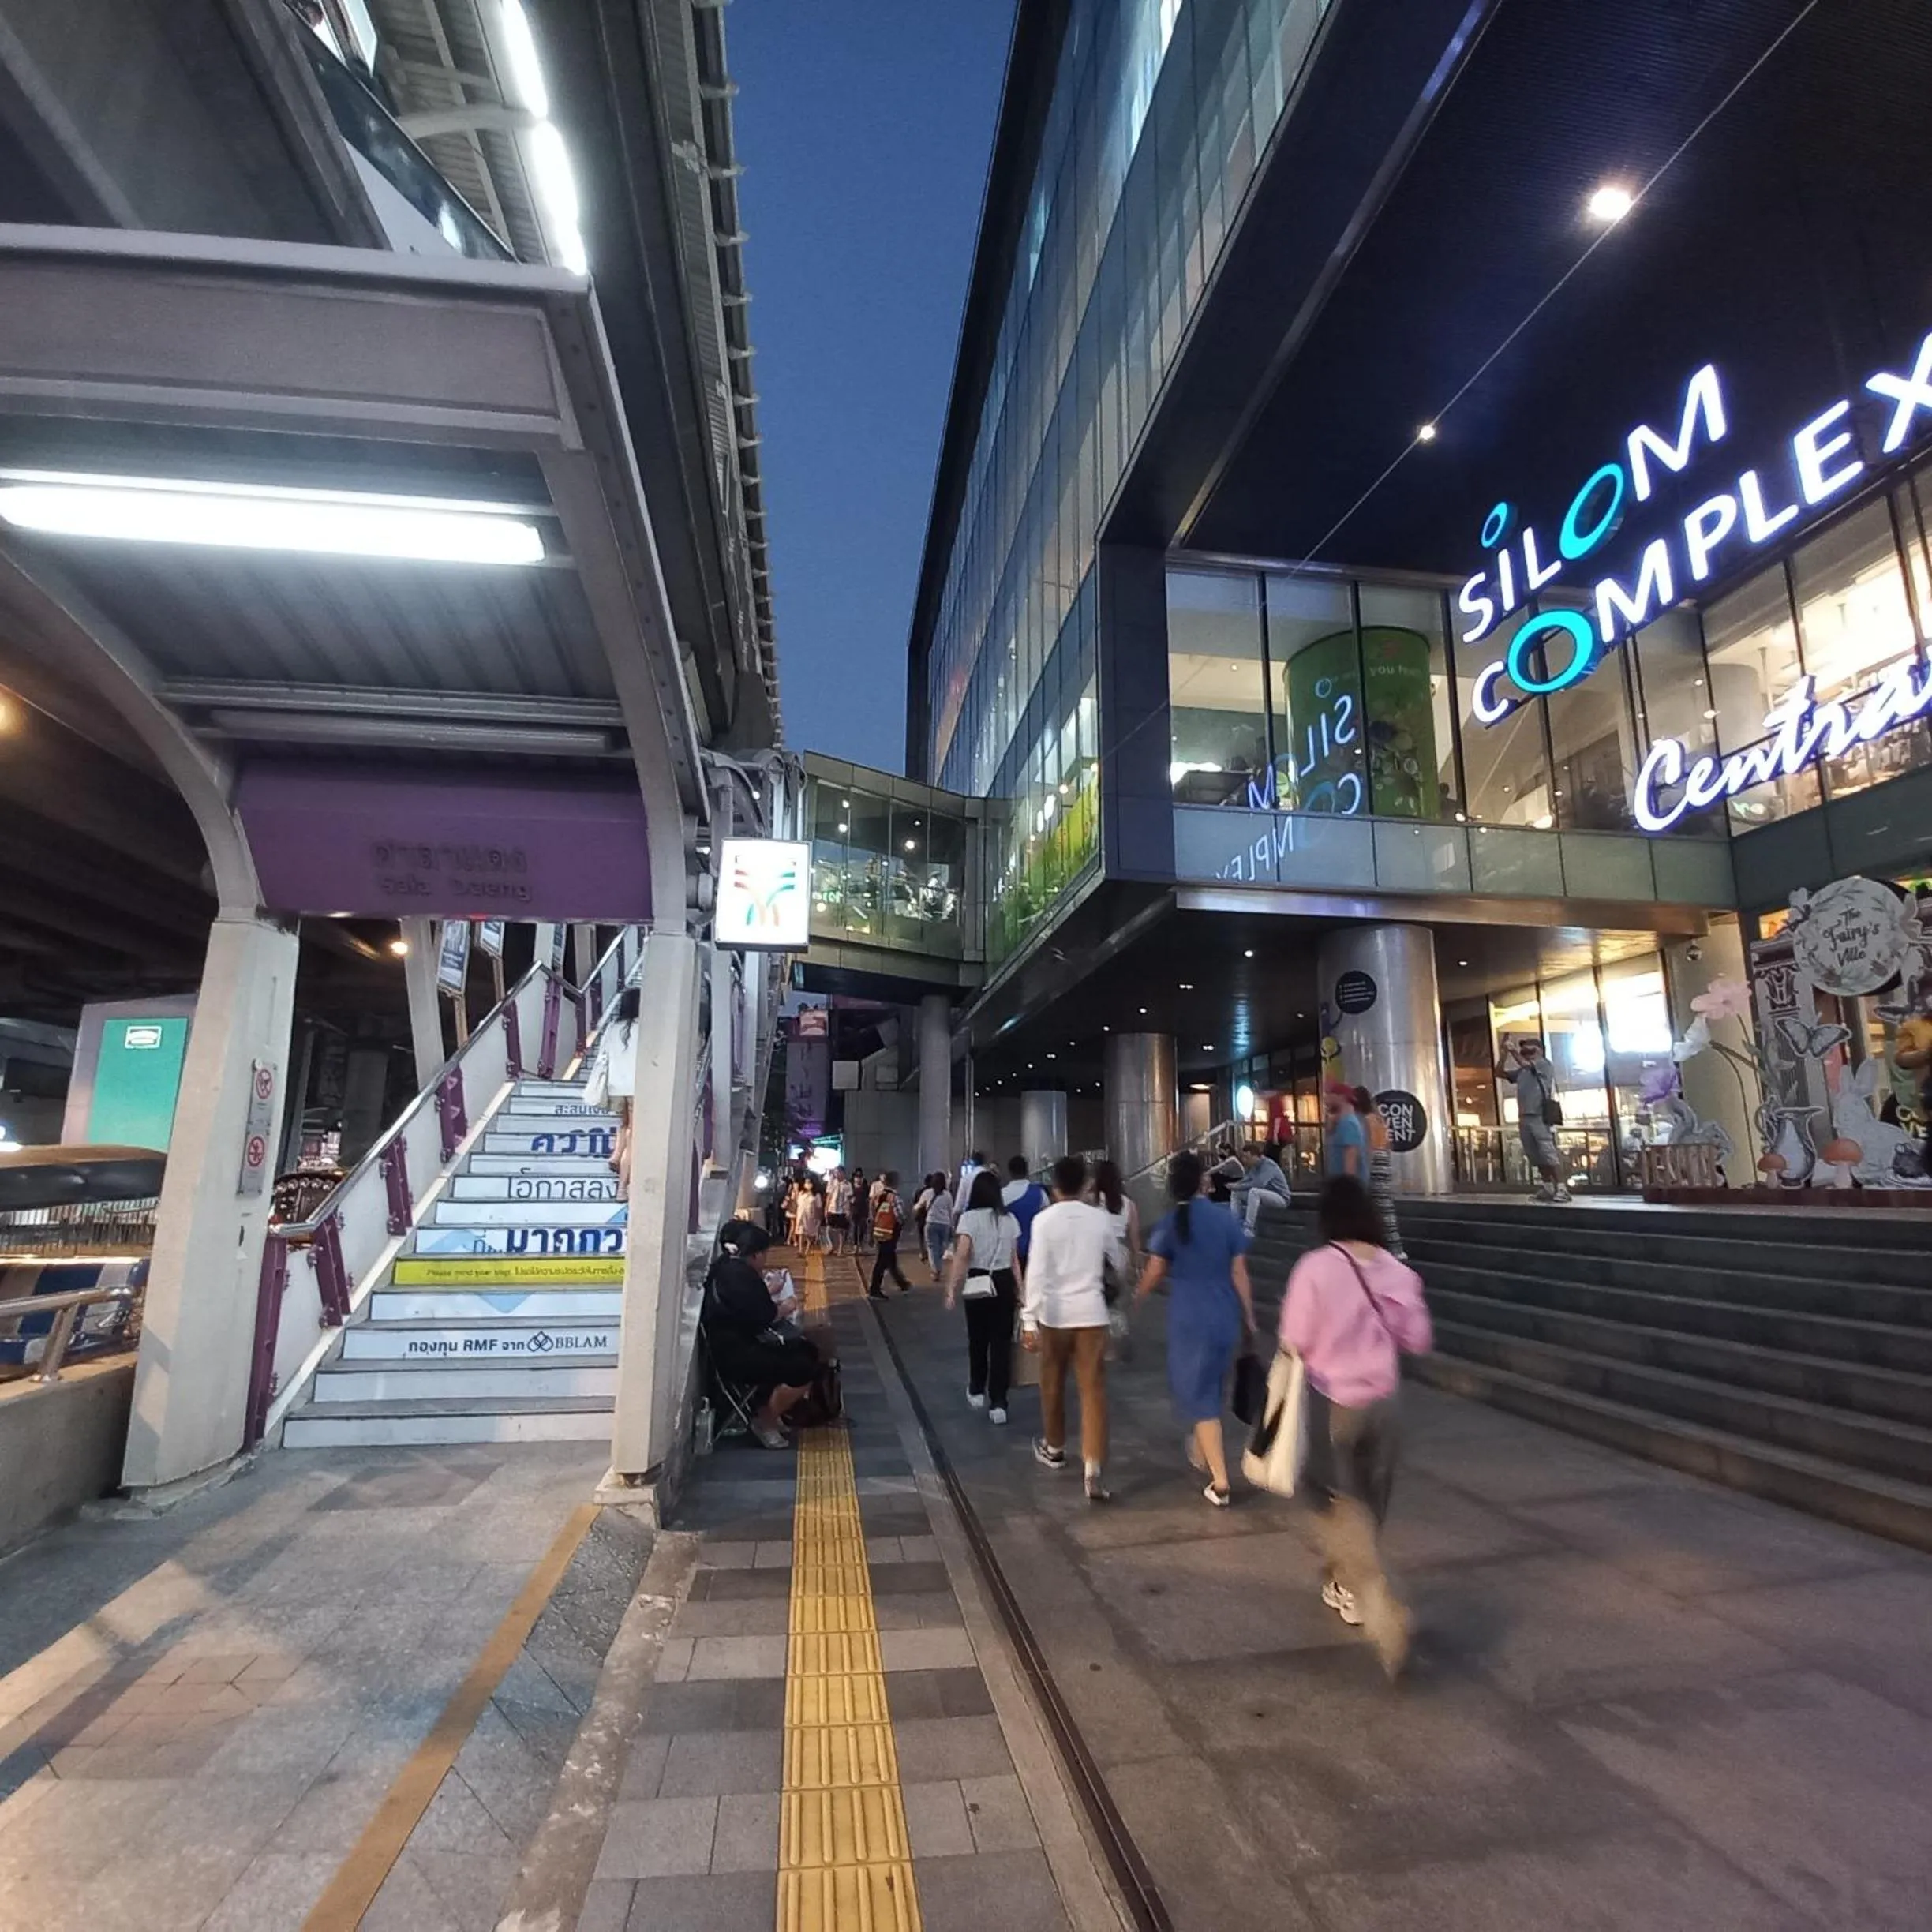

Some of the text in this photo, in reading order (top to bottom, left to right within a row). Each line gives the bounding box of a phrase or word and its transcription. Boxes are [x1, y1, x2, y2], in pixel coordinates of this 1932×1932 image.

[1458, 363, 1727, 643] SILOM
[1471, 331, 1932, 724] COMPLEX
[1634, 646, 1932, 831] Centra
[1839, 908, 1862, 926] The
[1822, 919, 1880, 952] Fairy's
[1378, 1103, 1413, 1117] CON
[1385, 1129, 1416, 1142] ENT
[408, 1335, 608, 1356] กองทุน RMF จาก BBLAM
